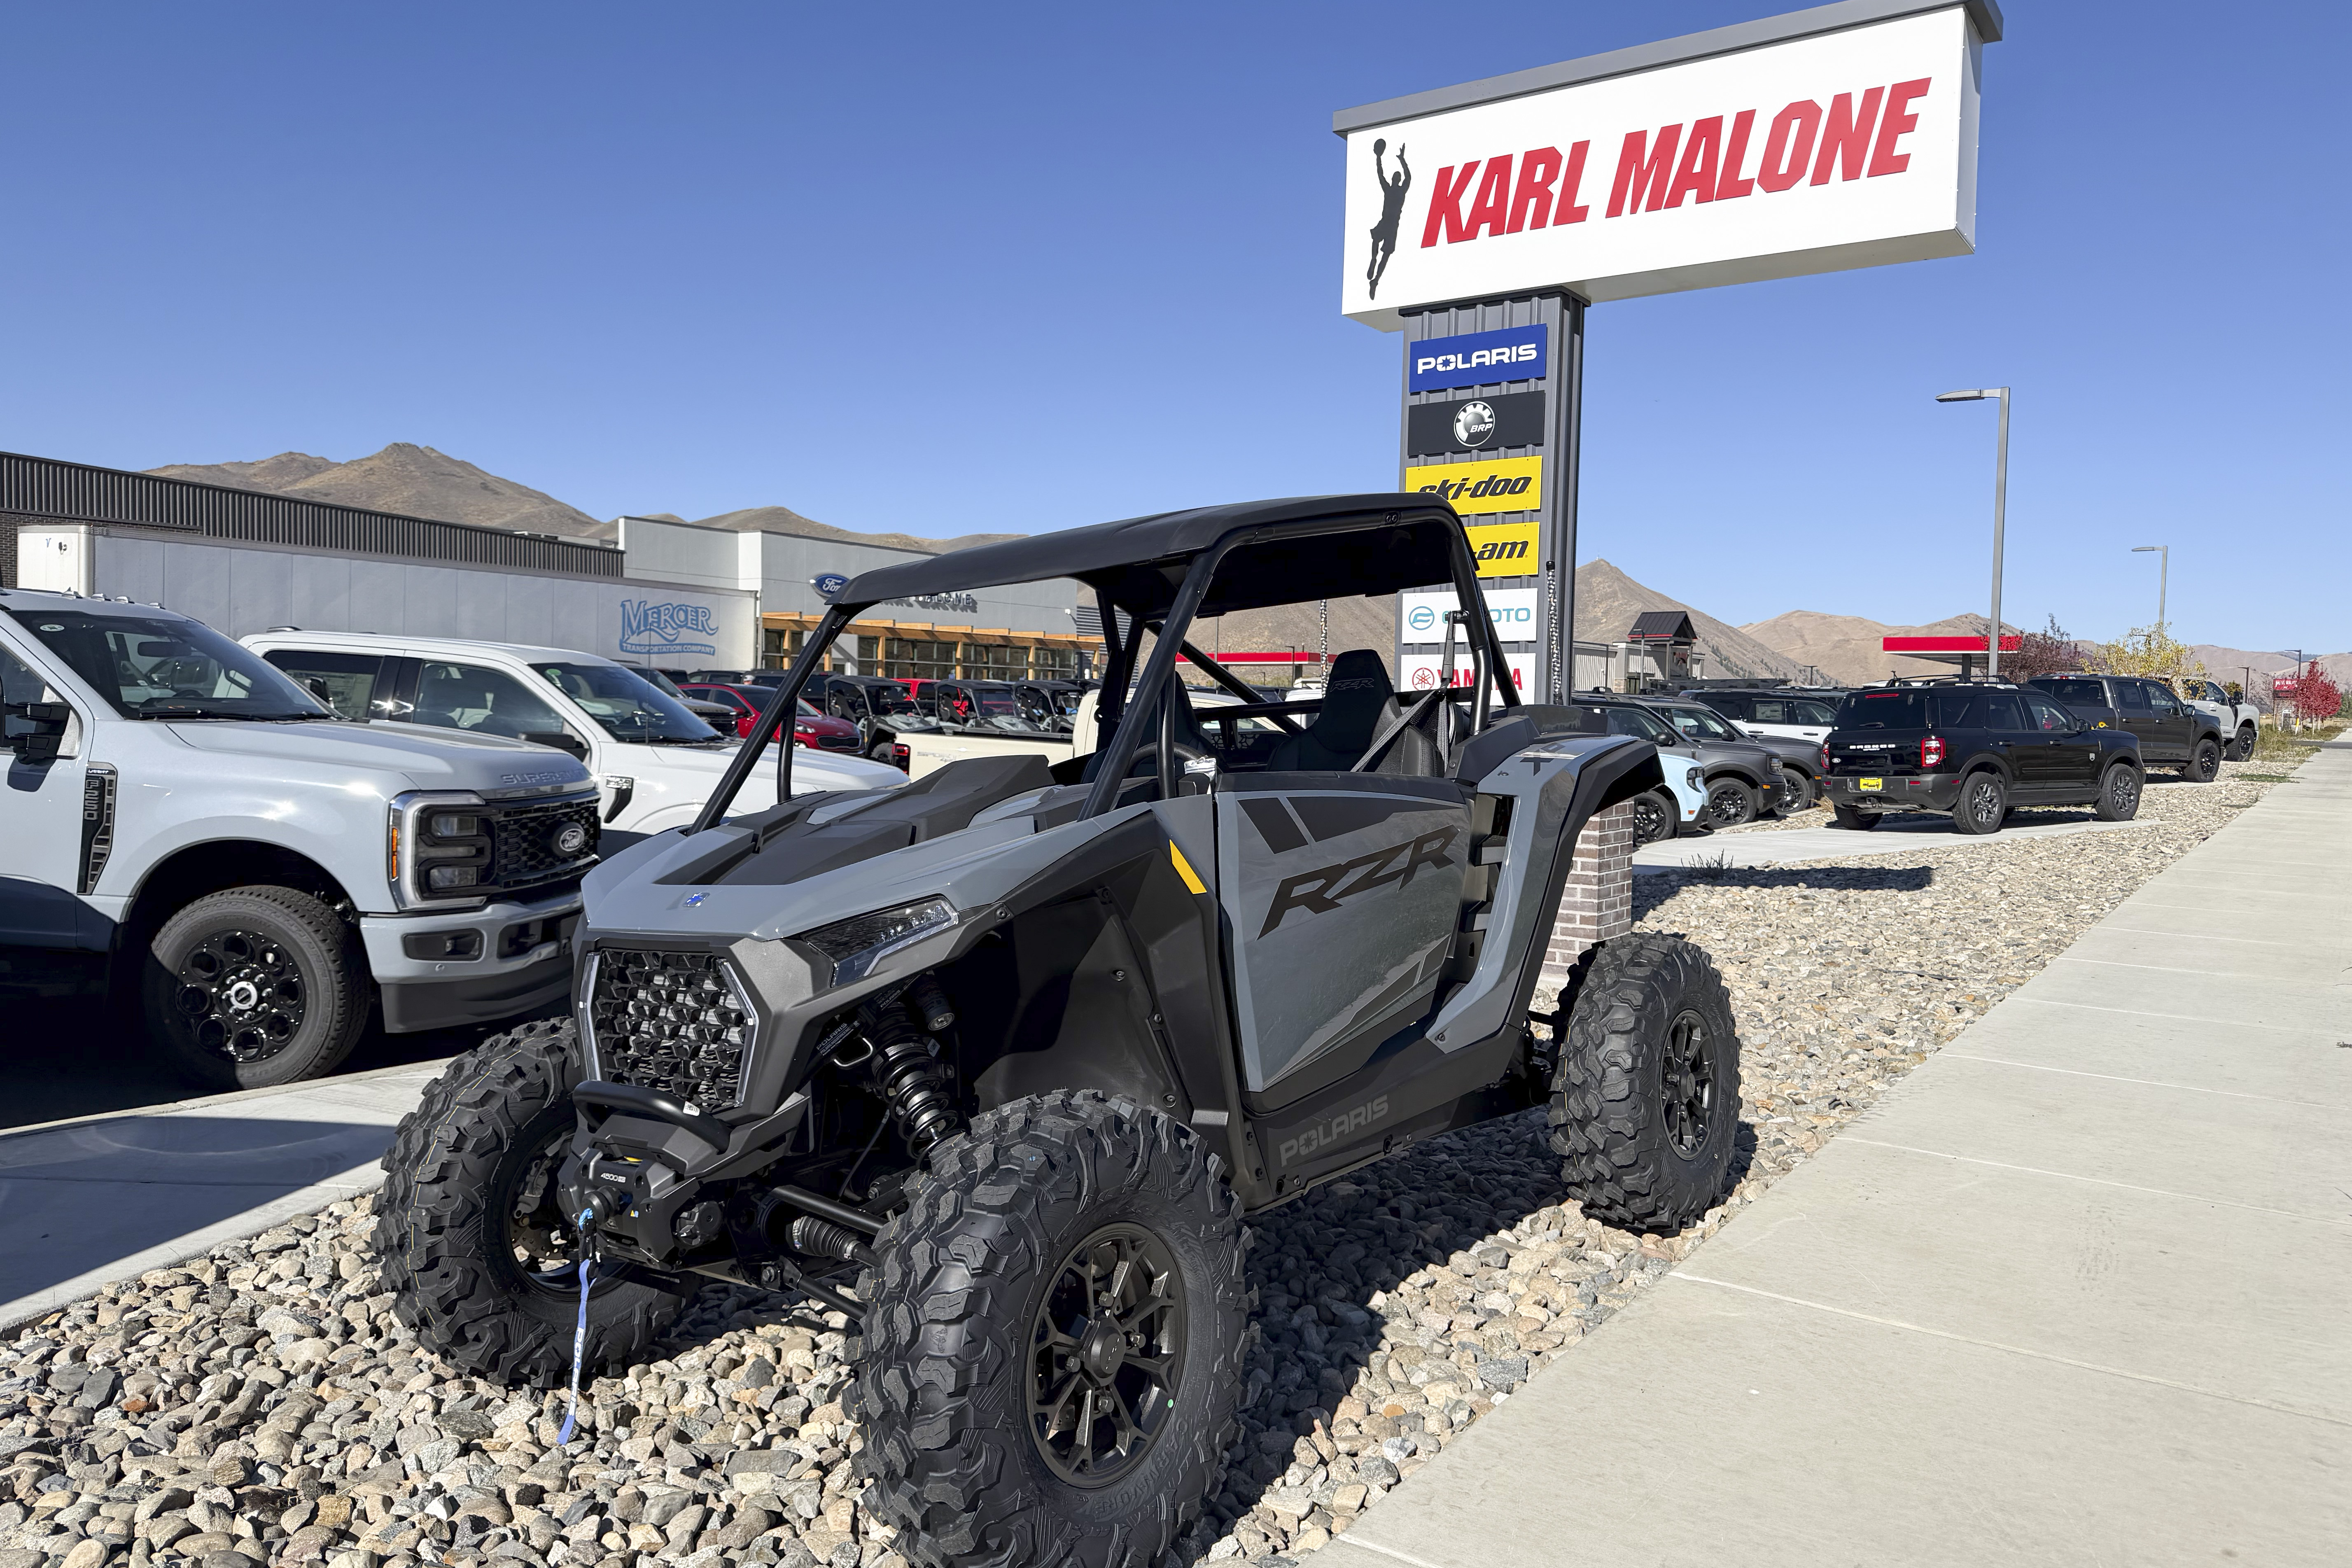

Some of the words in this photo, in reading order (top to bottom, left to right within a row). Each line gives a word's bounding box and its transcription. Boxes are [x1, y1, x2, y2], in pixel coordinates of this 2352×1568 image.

[1421, 140, 1590, 249] KARL
[1605, 77, 1932, 218] MALONE
[1417, 344, 1537, 374] POLARIS
[1470, 423, 1493, 433] BRP
[822, 578, 842, 592] For
[622, 643, 680, 653] TRANSPORTATION
[683, 644, 715, 655] COMPANY
[1330, 678, 1374, 693] RZR
[501, 772, 560, 785] SUPER
[1256, 824, 1461, 941] RZR
[880, 990, 901, 1008] POLARIS
[816, 1022, 847, 1049] POLARIS
[1279, 1094, 1388, 1167] POLARIS
[600, 1173, 618, 1181] 4500
[569, 1327, 584, 1416] POLARIS
